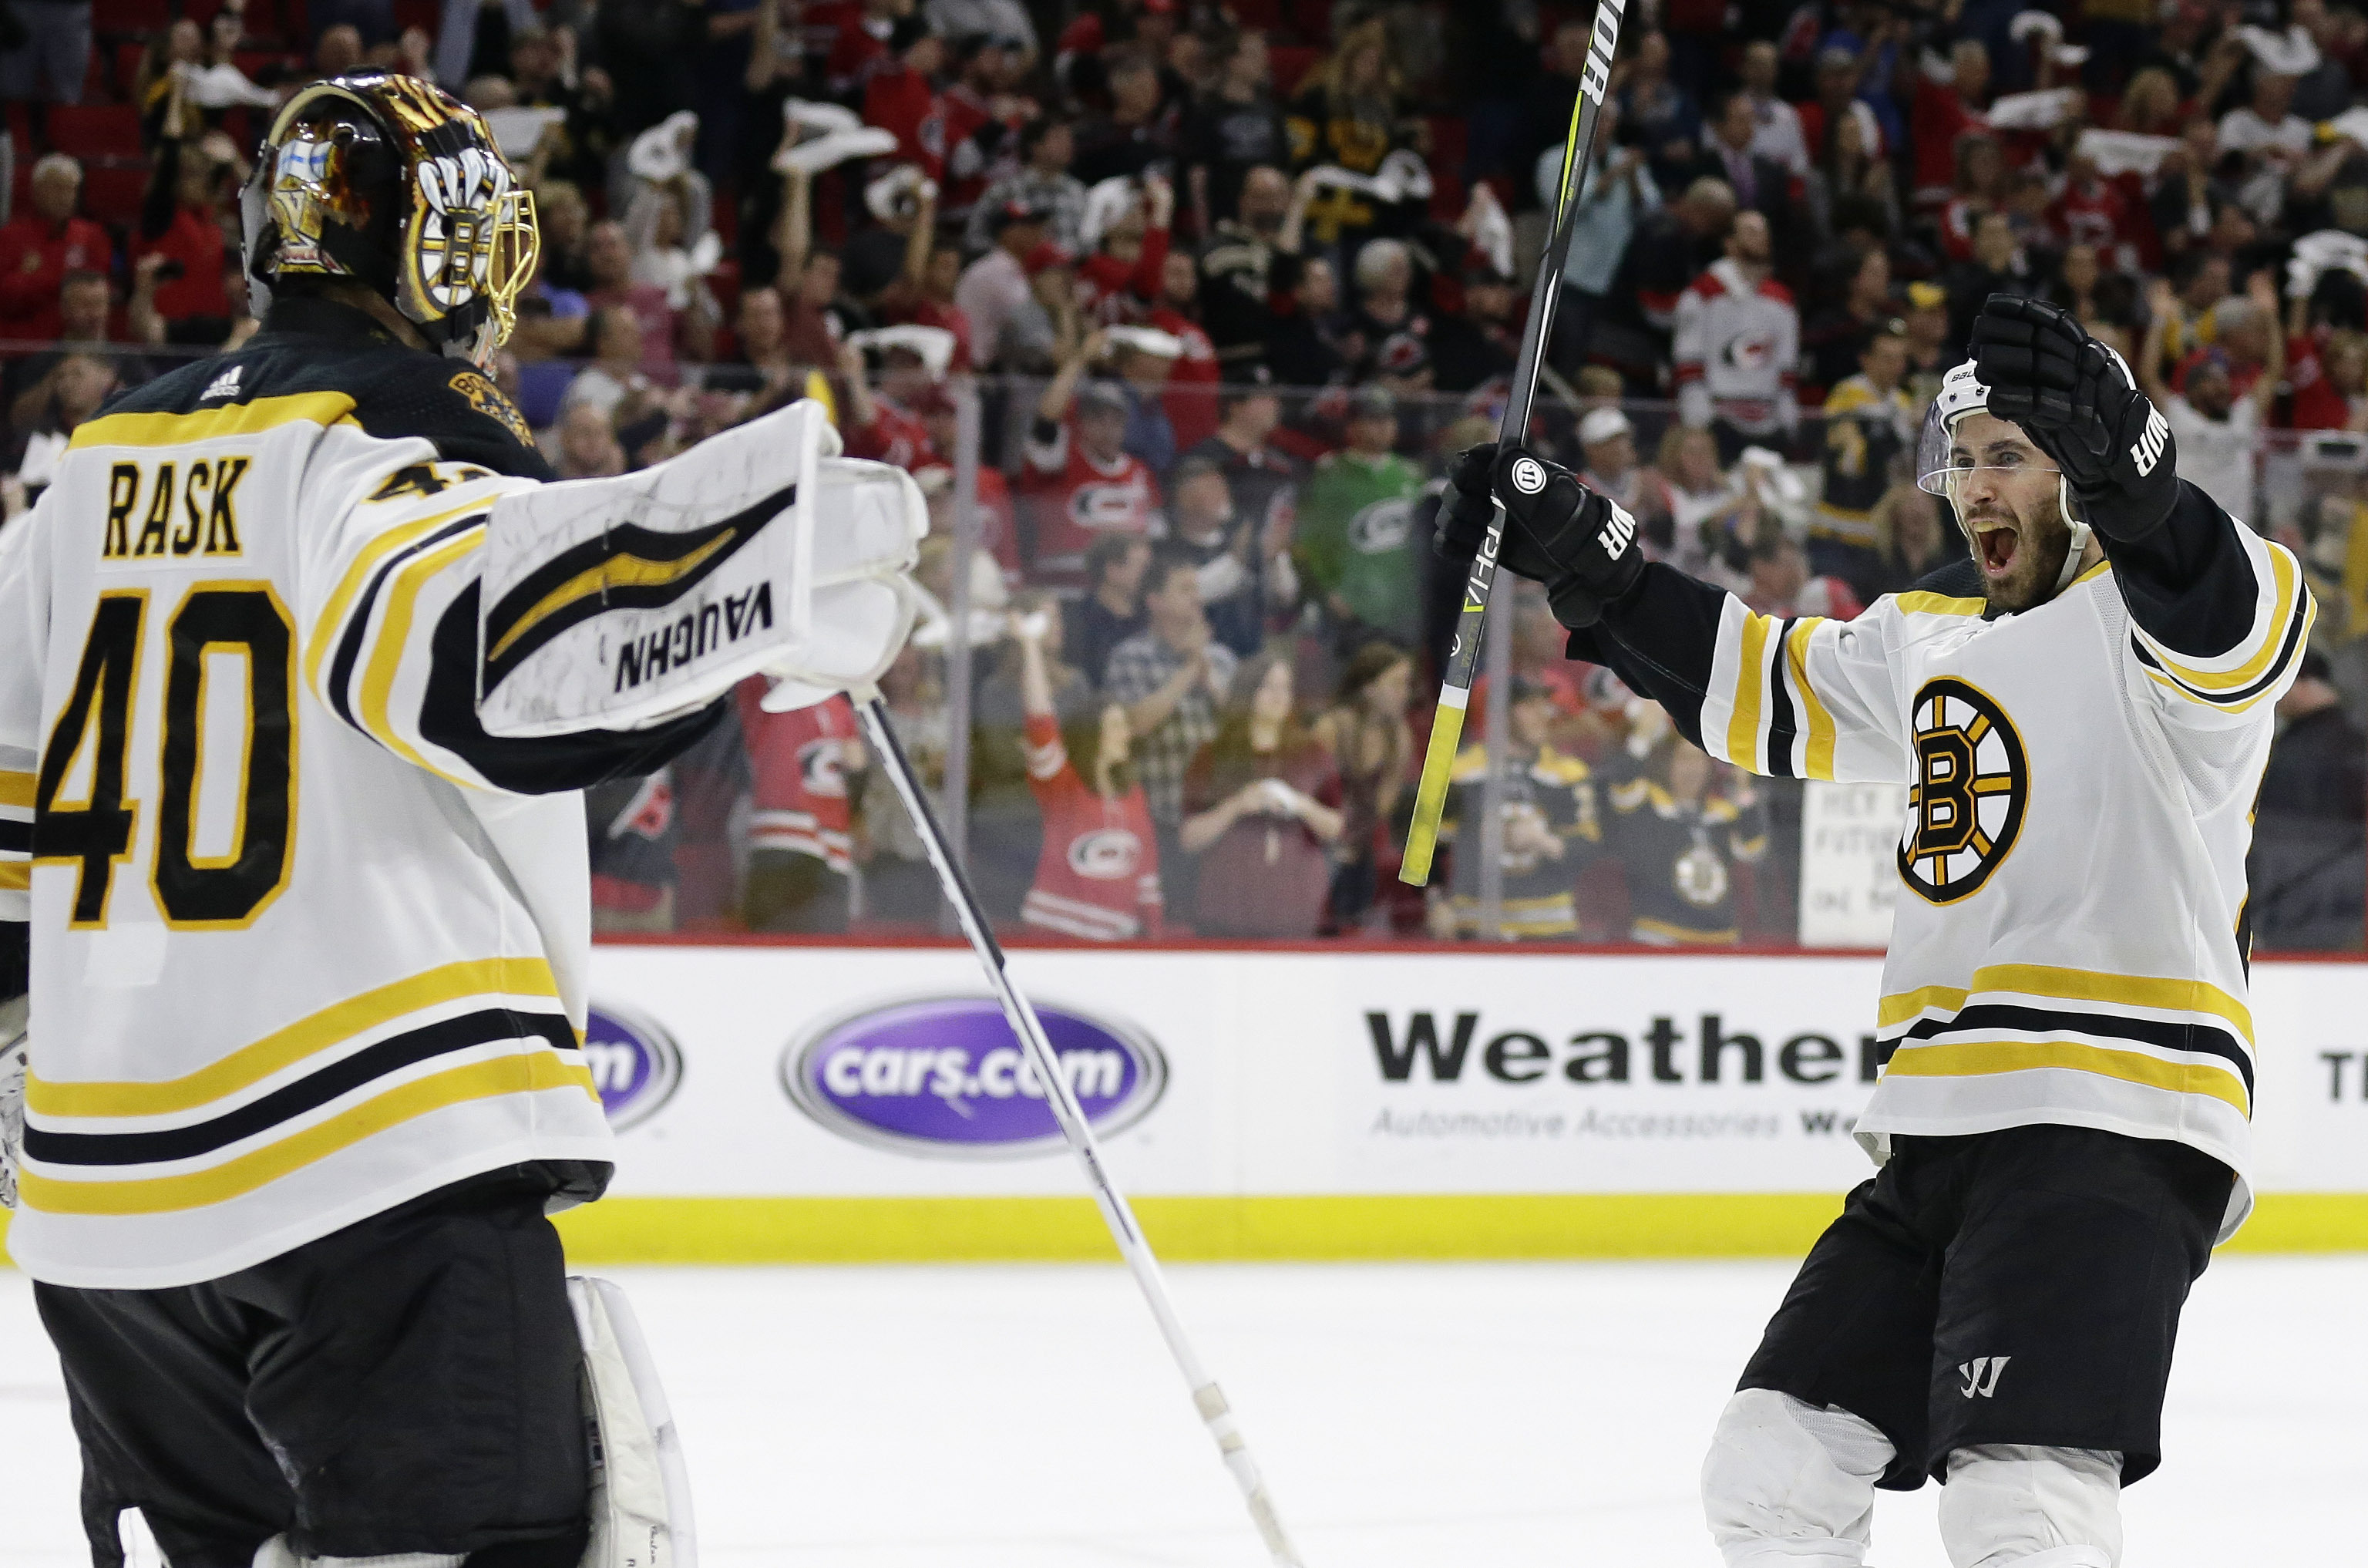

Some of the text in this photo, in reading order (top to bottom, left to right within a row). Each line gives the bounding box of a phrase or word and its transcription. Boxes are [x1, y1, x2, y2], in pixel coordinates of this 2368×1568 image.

[102, 453, 253, 561] RASK
[614, 580, 773, 694] VAUGHN
[30, 578, 300, 932] 40
[1370, 1107, 1566, 1138] Automotive
[1576, 1107, 1781, 1137] Accessories
